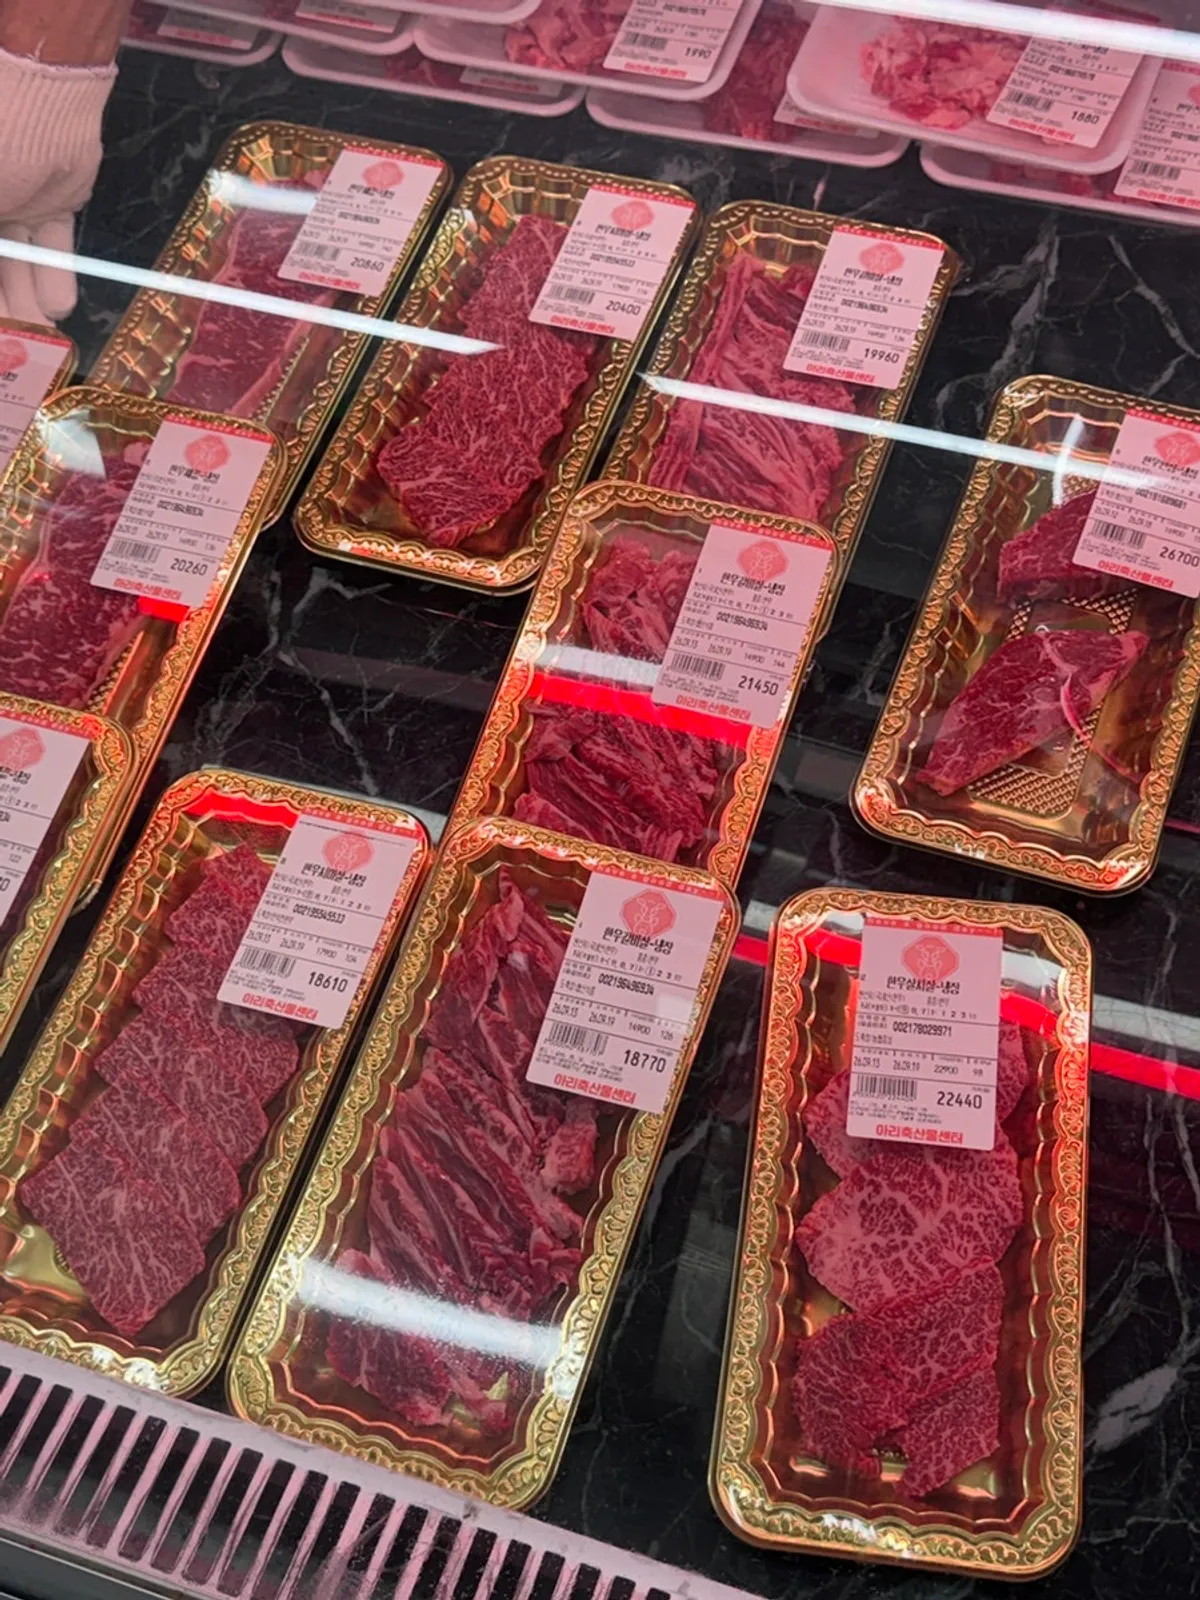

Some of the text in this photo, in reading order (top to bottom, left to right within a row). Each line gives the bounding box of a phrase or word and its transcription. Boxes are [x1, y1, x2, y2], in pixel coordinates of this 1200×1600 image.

[605, 300, 641, 315] 20400
[865, 348, 900, 363] 19960
[170, 558, 208, 576] 20260
[1159, 546, 1200, 567] 26700
[738, 675, 779, 696] 21450
[603, 927, 673, 955] 한우갈비살-냉장
[308, 971, 348, 992] 18610
[887, 976, 960, 995] 한우살치살-냉장
[242, 993, 318, 1020] 아리축산물센터
[624, 1049, 666, 1073] 18770
[554, 1074, 636, 1104] 아리축산물센터
[937, 1091, 982, 1109] 22440
[876, 1124, 963, 1144] 아리축산물센터
